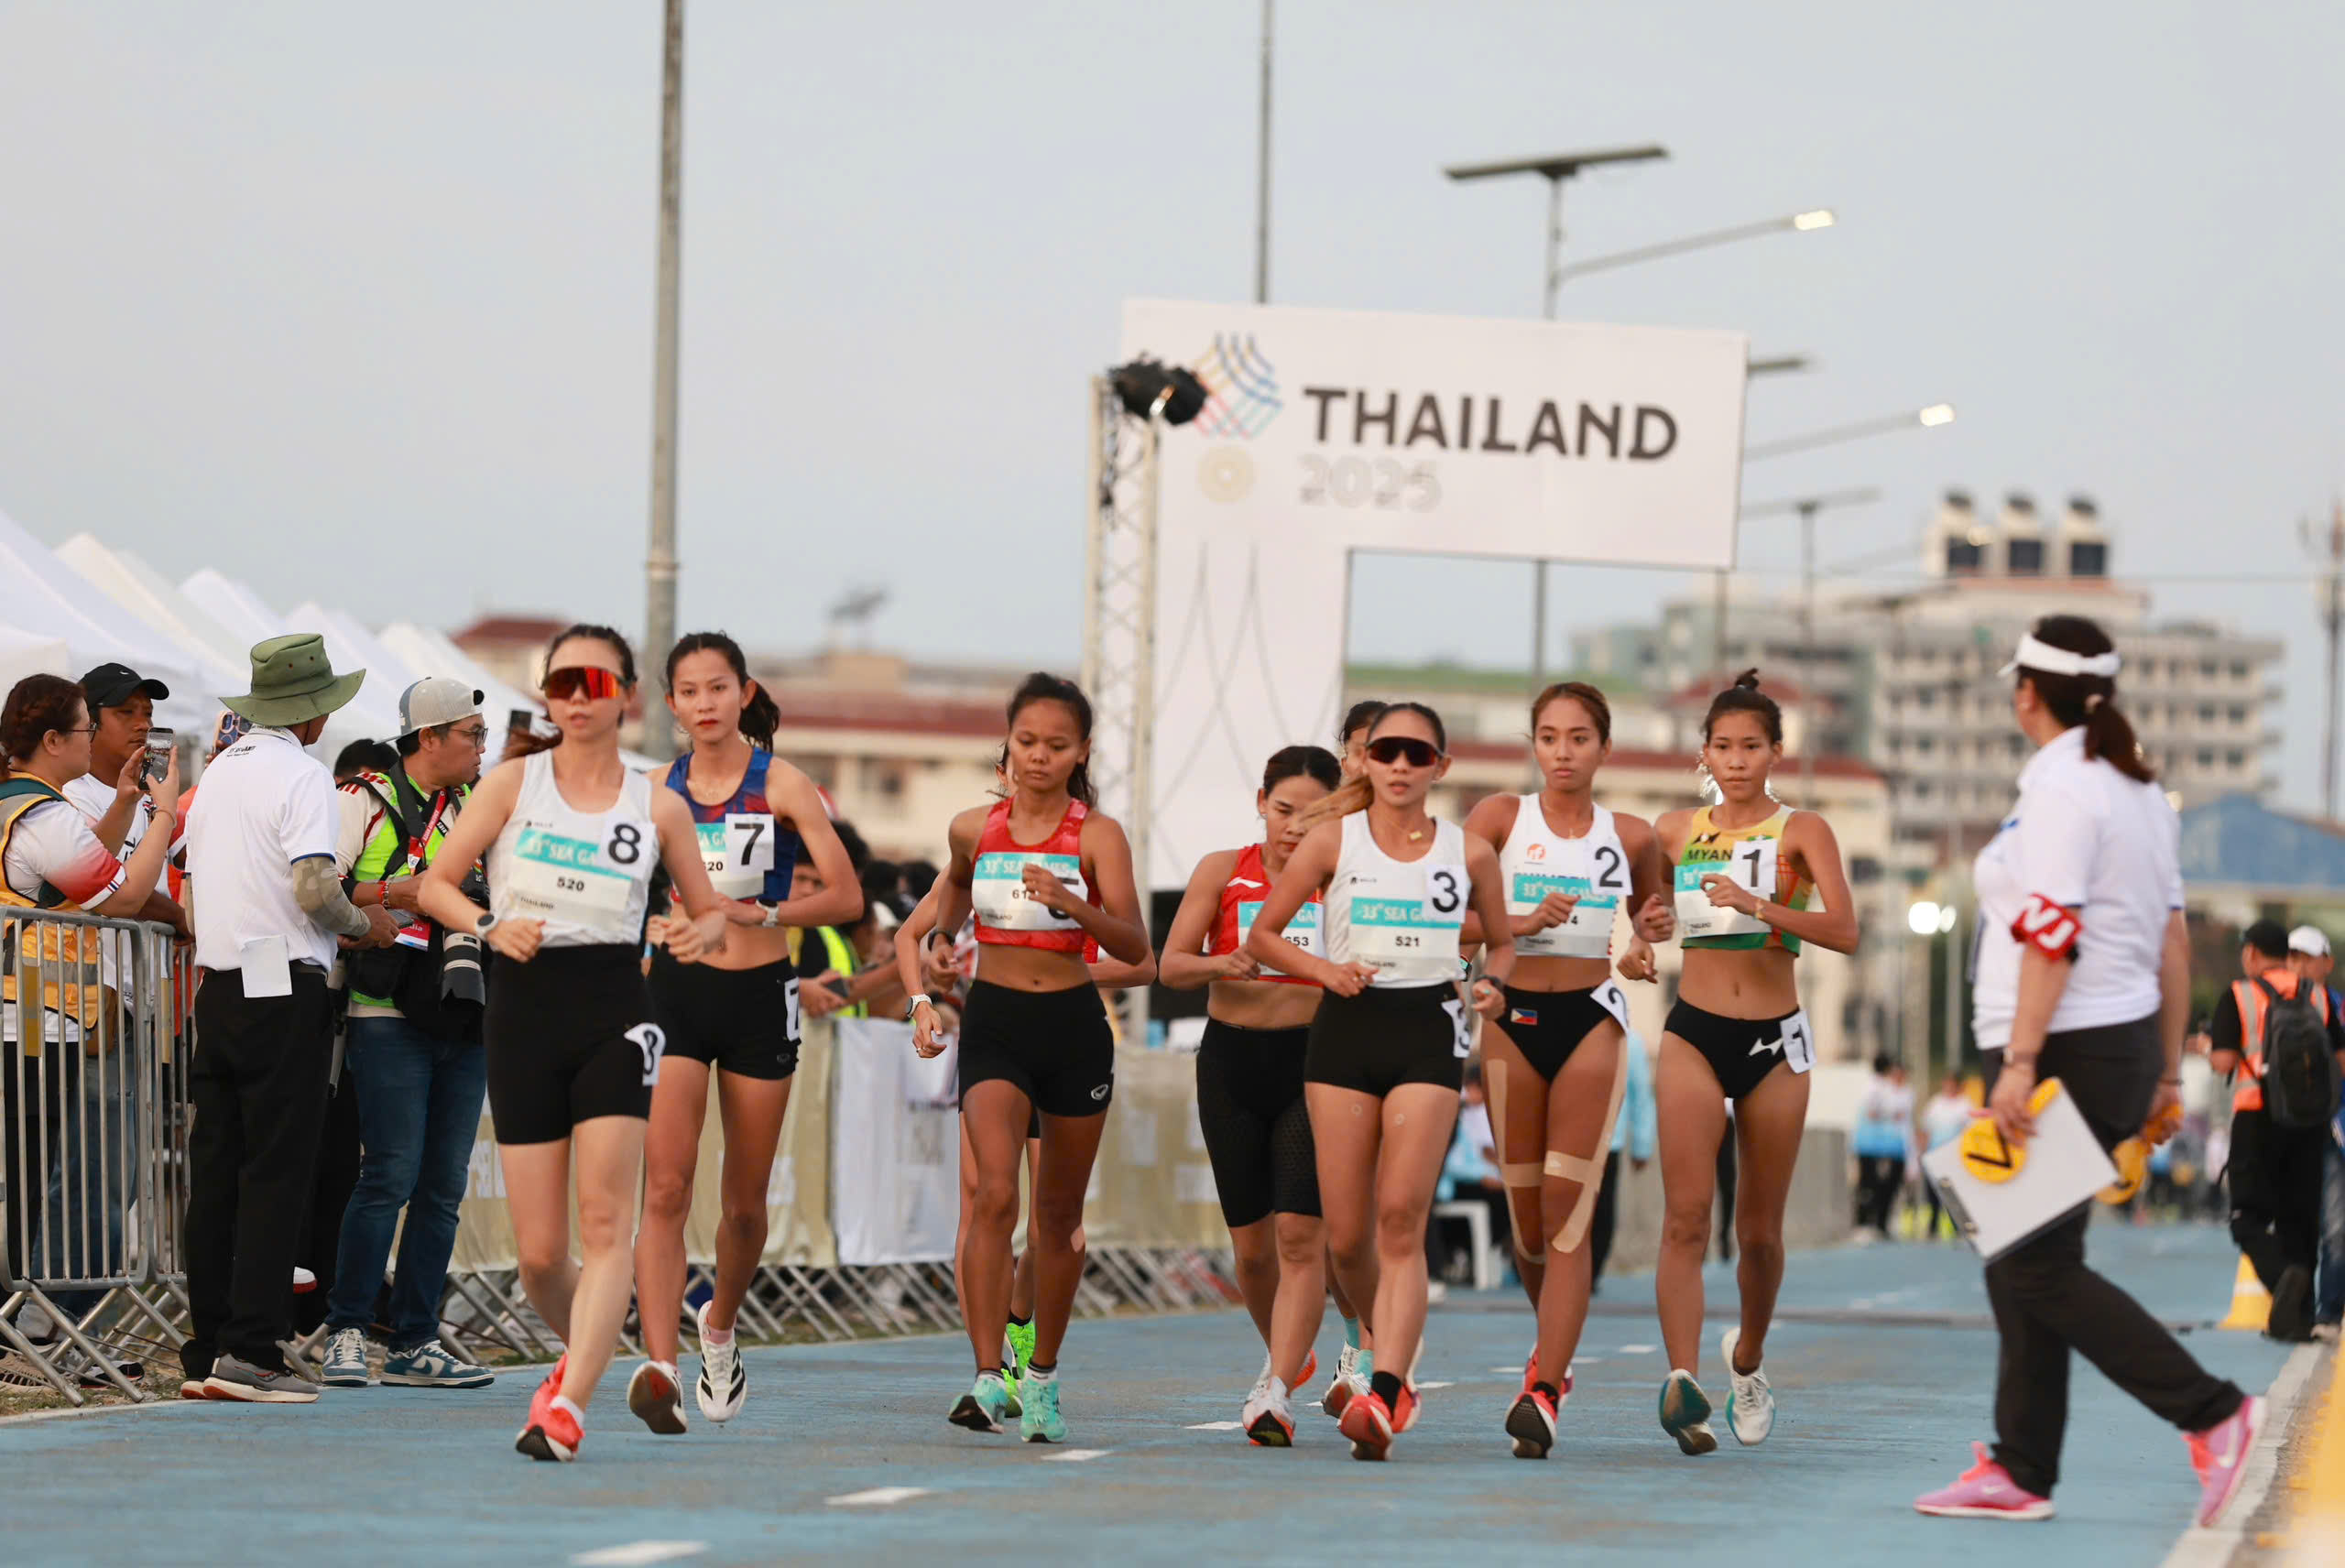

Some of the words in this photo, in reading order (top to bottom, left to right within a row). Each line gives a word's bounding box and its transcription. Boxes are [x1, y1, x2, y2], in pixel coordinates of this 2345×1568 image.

[1303, 387, 1677, 460] THAILAND
[1299, 455, 1442, 512] 2025
[551, 844, 573, 860] SEA
[607, 823, 641, 865] 8
[734, 822, 765, 866] 7
[556, 877, 584, 891] 520
[1595, 846, 1623, 887] 2
[1742, 848, 1761, 888] 1
[1432, 871, 1460, 913] 3
[1385, 906, 1408, 921] SEA
[1395, 936, 1420, 947] 521
[643, 1029, 658, 1075] 8
[1791, 1023, 1809, 1063] 1
